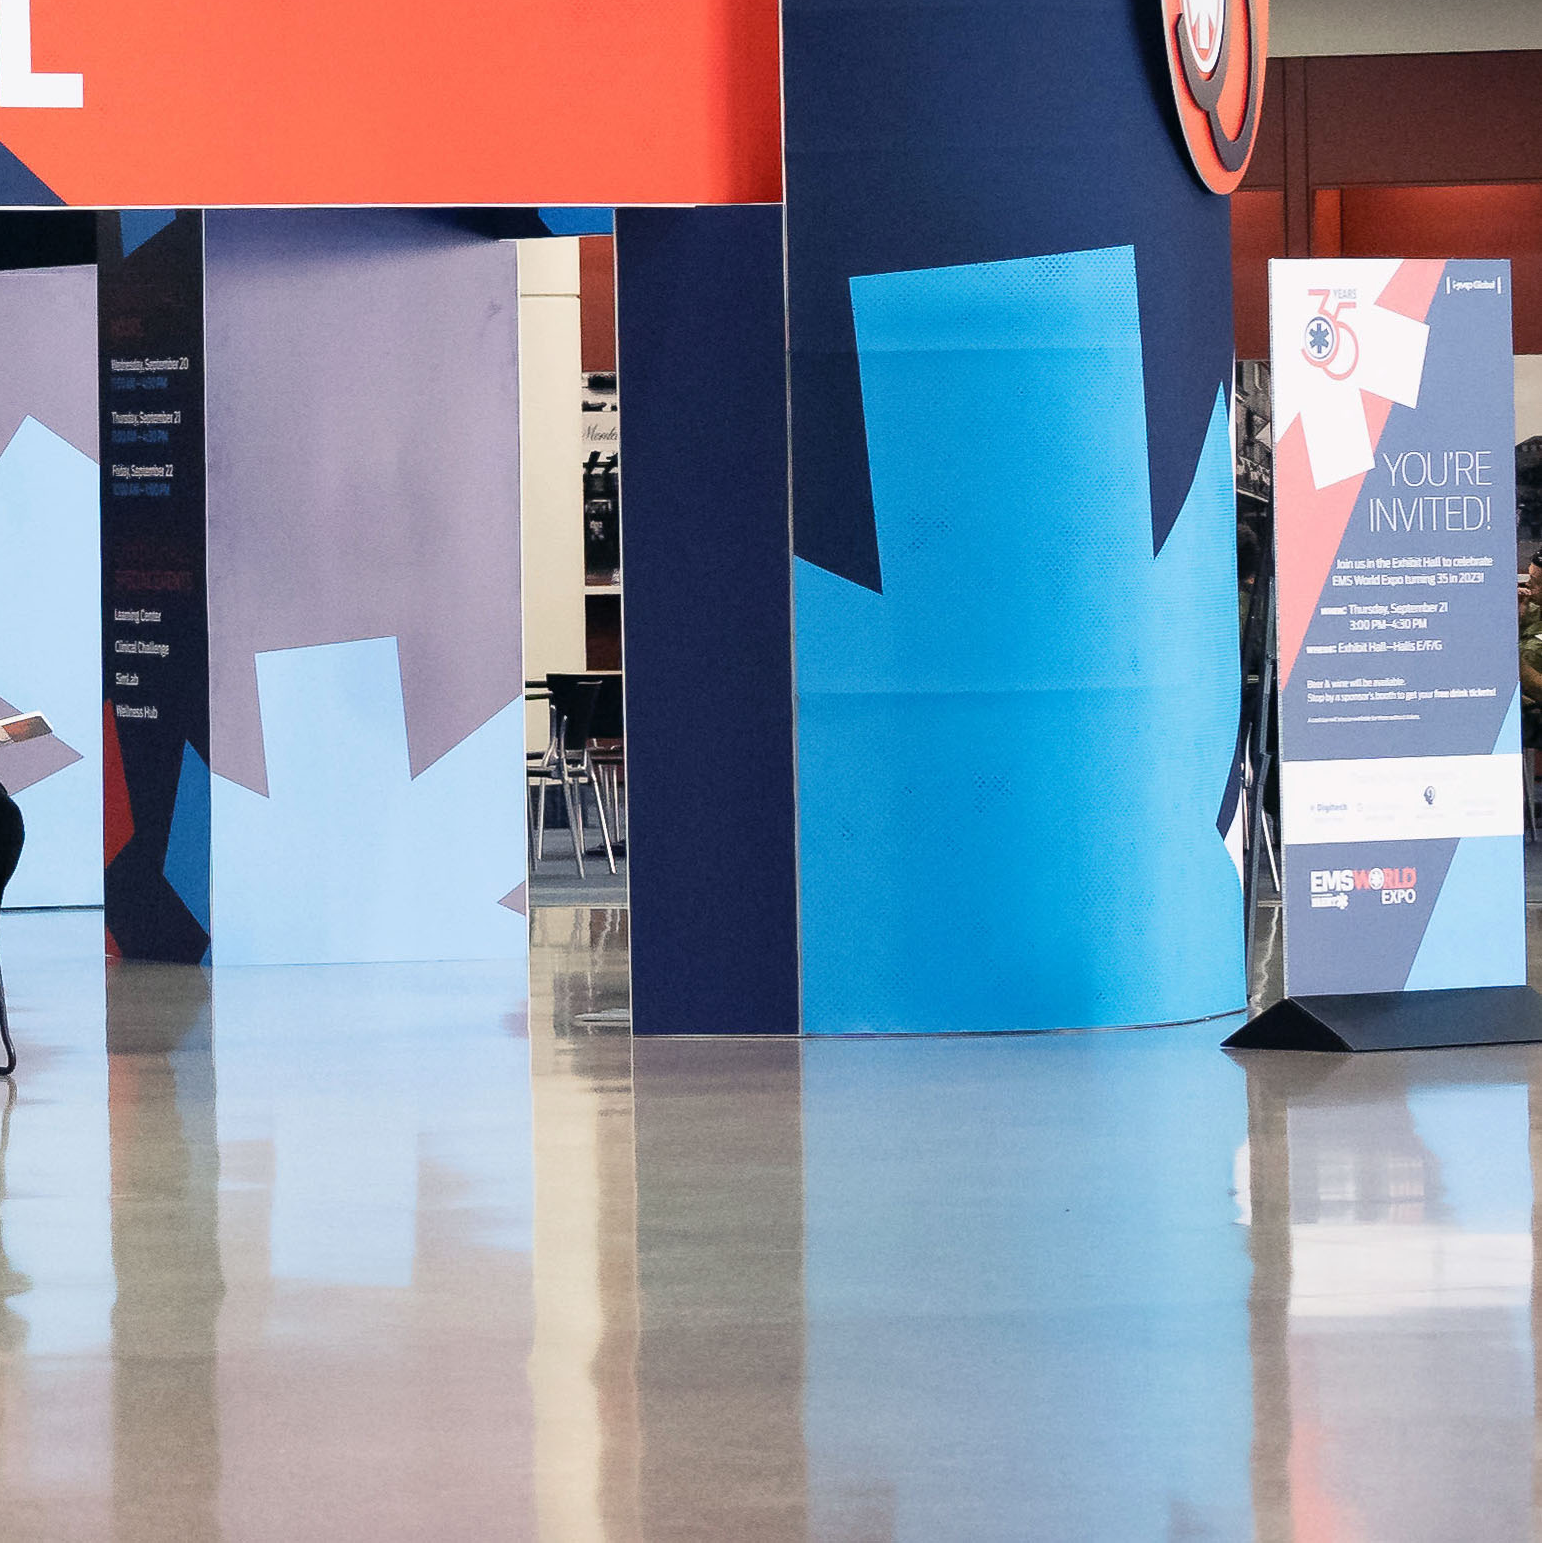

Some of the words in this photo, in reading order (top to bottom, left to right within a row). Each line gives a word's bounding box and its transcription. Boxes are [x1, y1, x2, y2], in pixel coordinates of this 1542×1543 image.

[1333, 289, 1357, 299] YEARS
[1382, 450, 1492, 487] YOU'RE
[1369, 496, 1492, 532] INVITED!
[1336, 558, 1354, 569] Join
[1375, 558, 1391, 568] the
[1423, 556, 1441, 567] Hall
[1442, 556, 1452, 567] to
[1453, 556, 1493, 567] celebrate
[1332, 575, 1353, 586] EMS
[1354, 575, 1380, 585] World
[1381, 574, 1404, 586] Expo
[1436, 572, 1448, 584] 35
[1390, 602, 1437, 615] September
[1412, 618, 1427, 628] PM
[1381, 889, 1416, 904] EXPO
